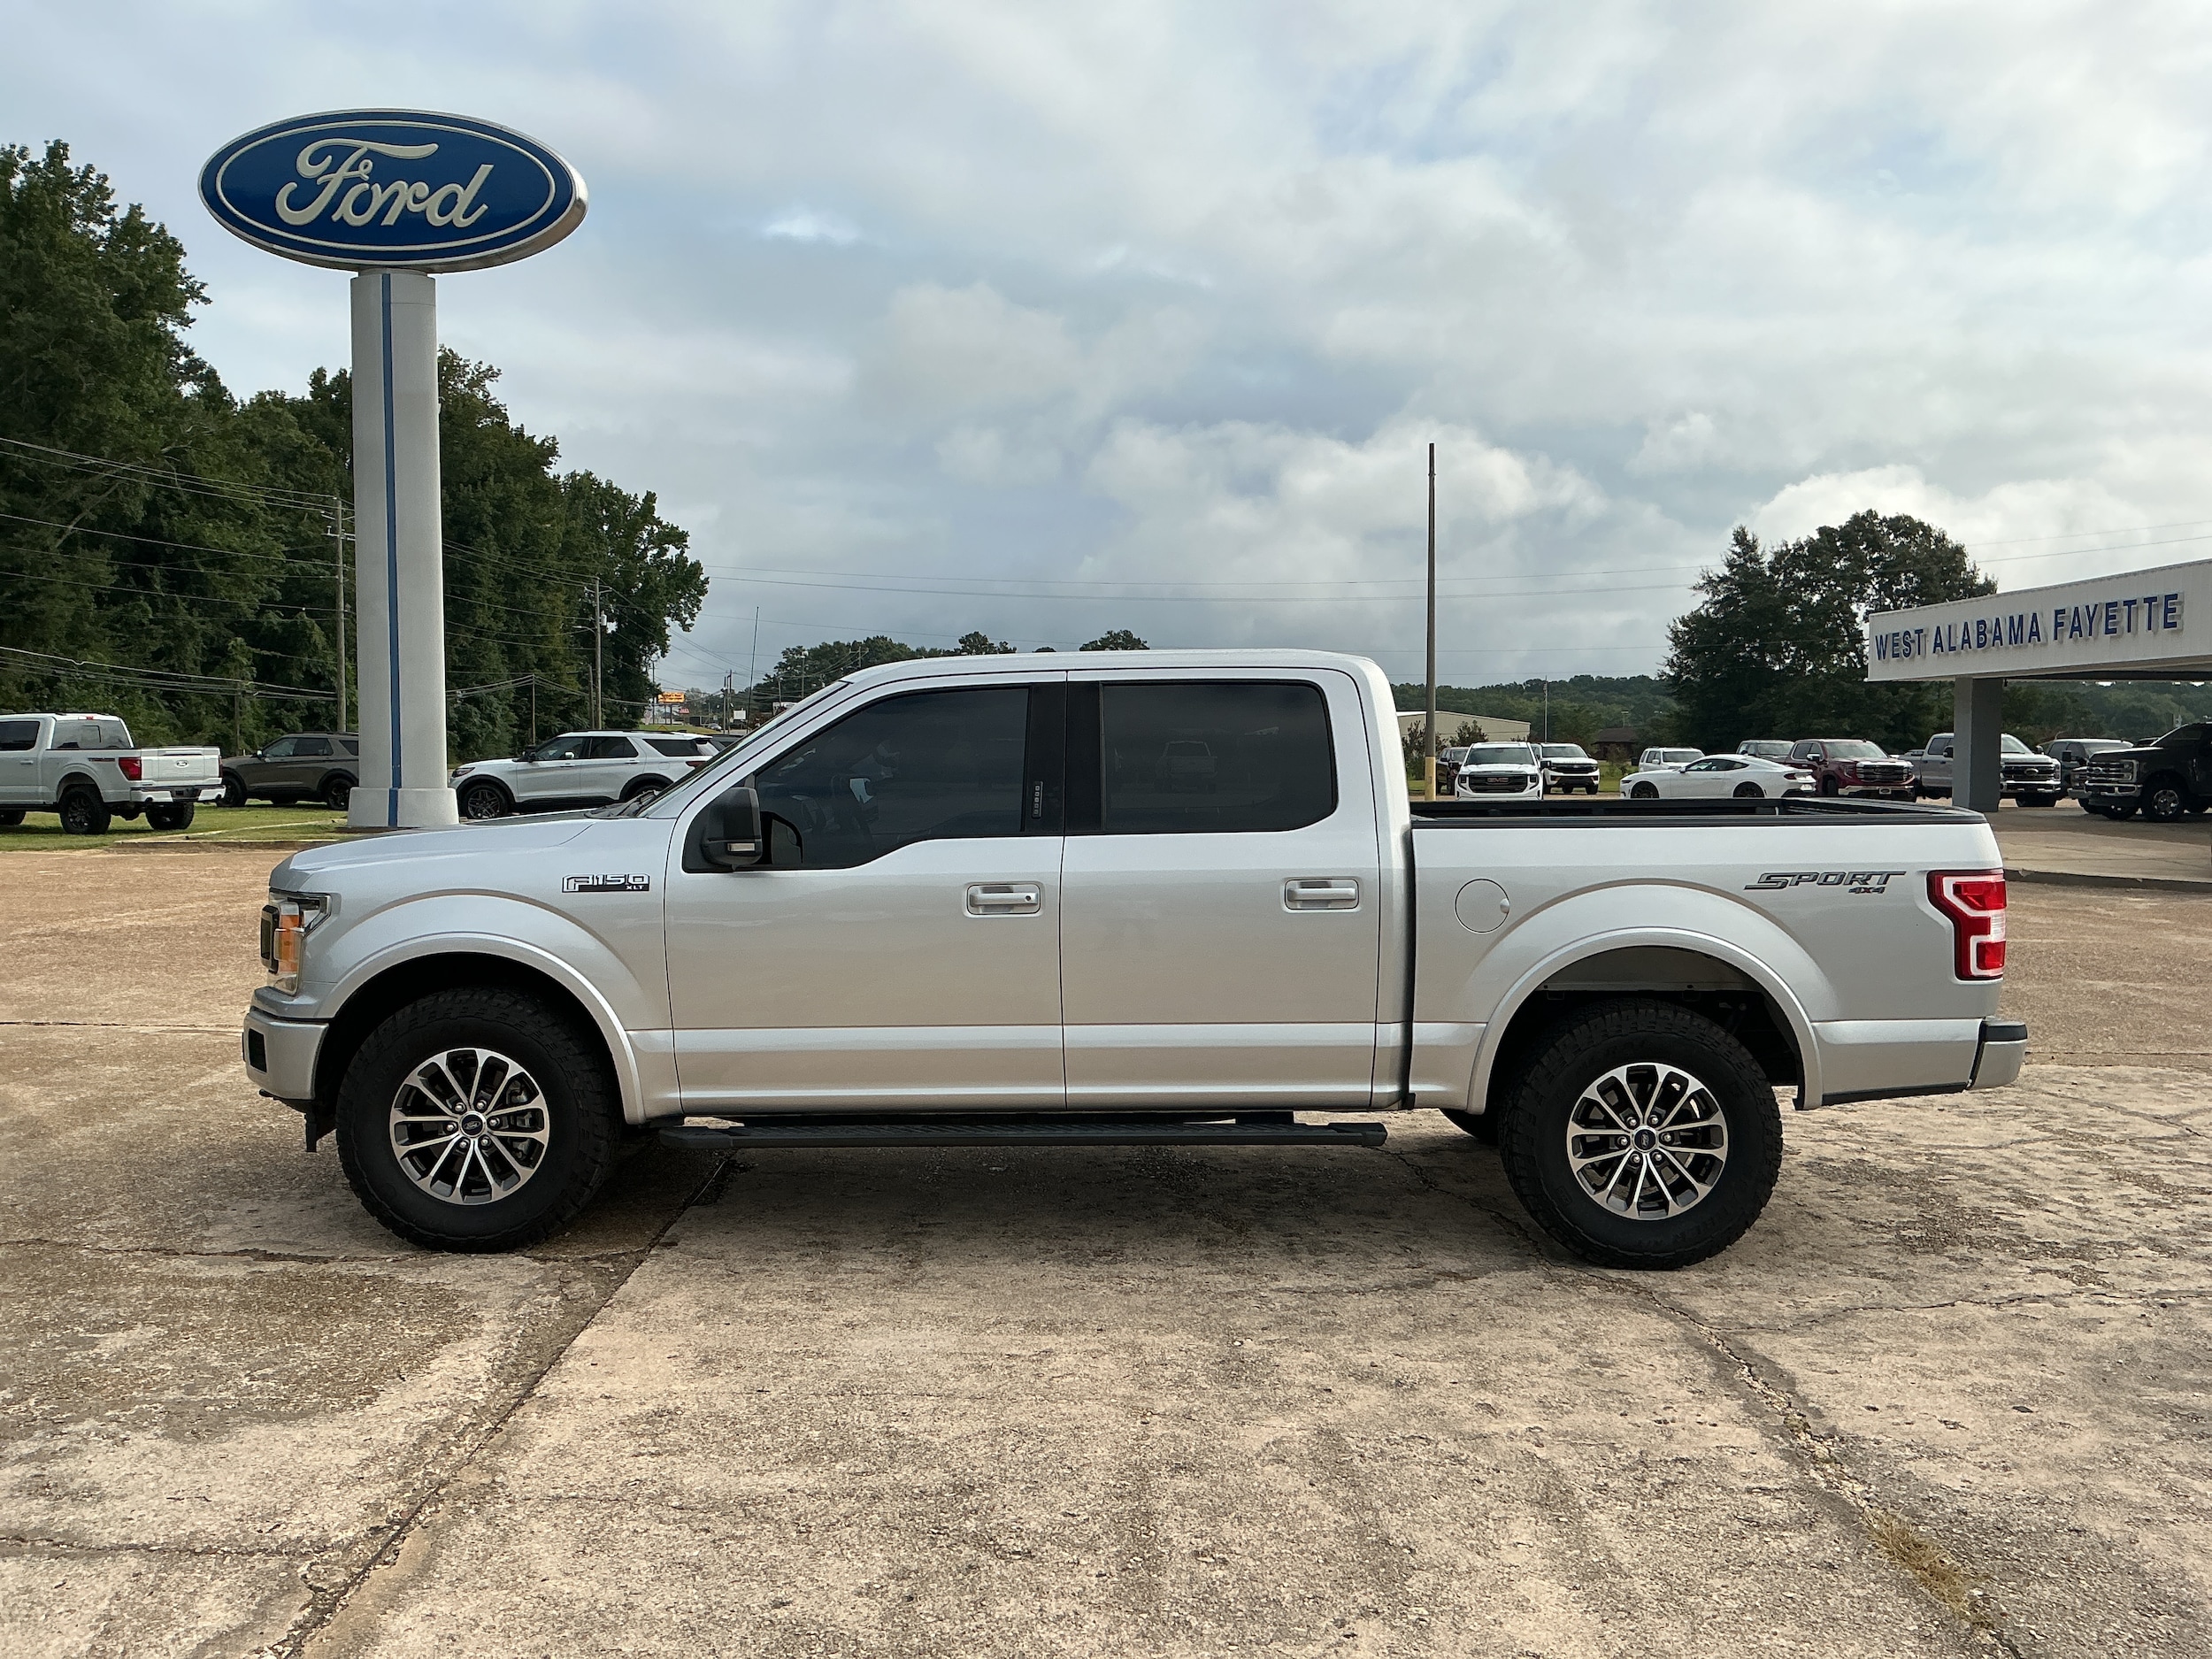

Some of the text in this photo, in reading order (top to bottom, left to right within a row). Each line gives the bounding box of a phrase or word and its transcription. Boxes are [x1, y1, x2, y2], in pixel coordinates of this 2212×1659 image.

[275, 138, 494, 227] Ford
[1875, 593, 2179, 661] WEST ALABAMA FAYETTE
[1743, 872, 1907, 890] SPORT
